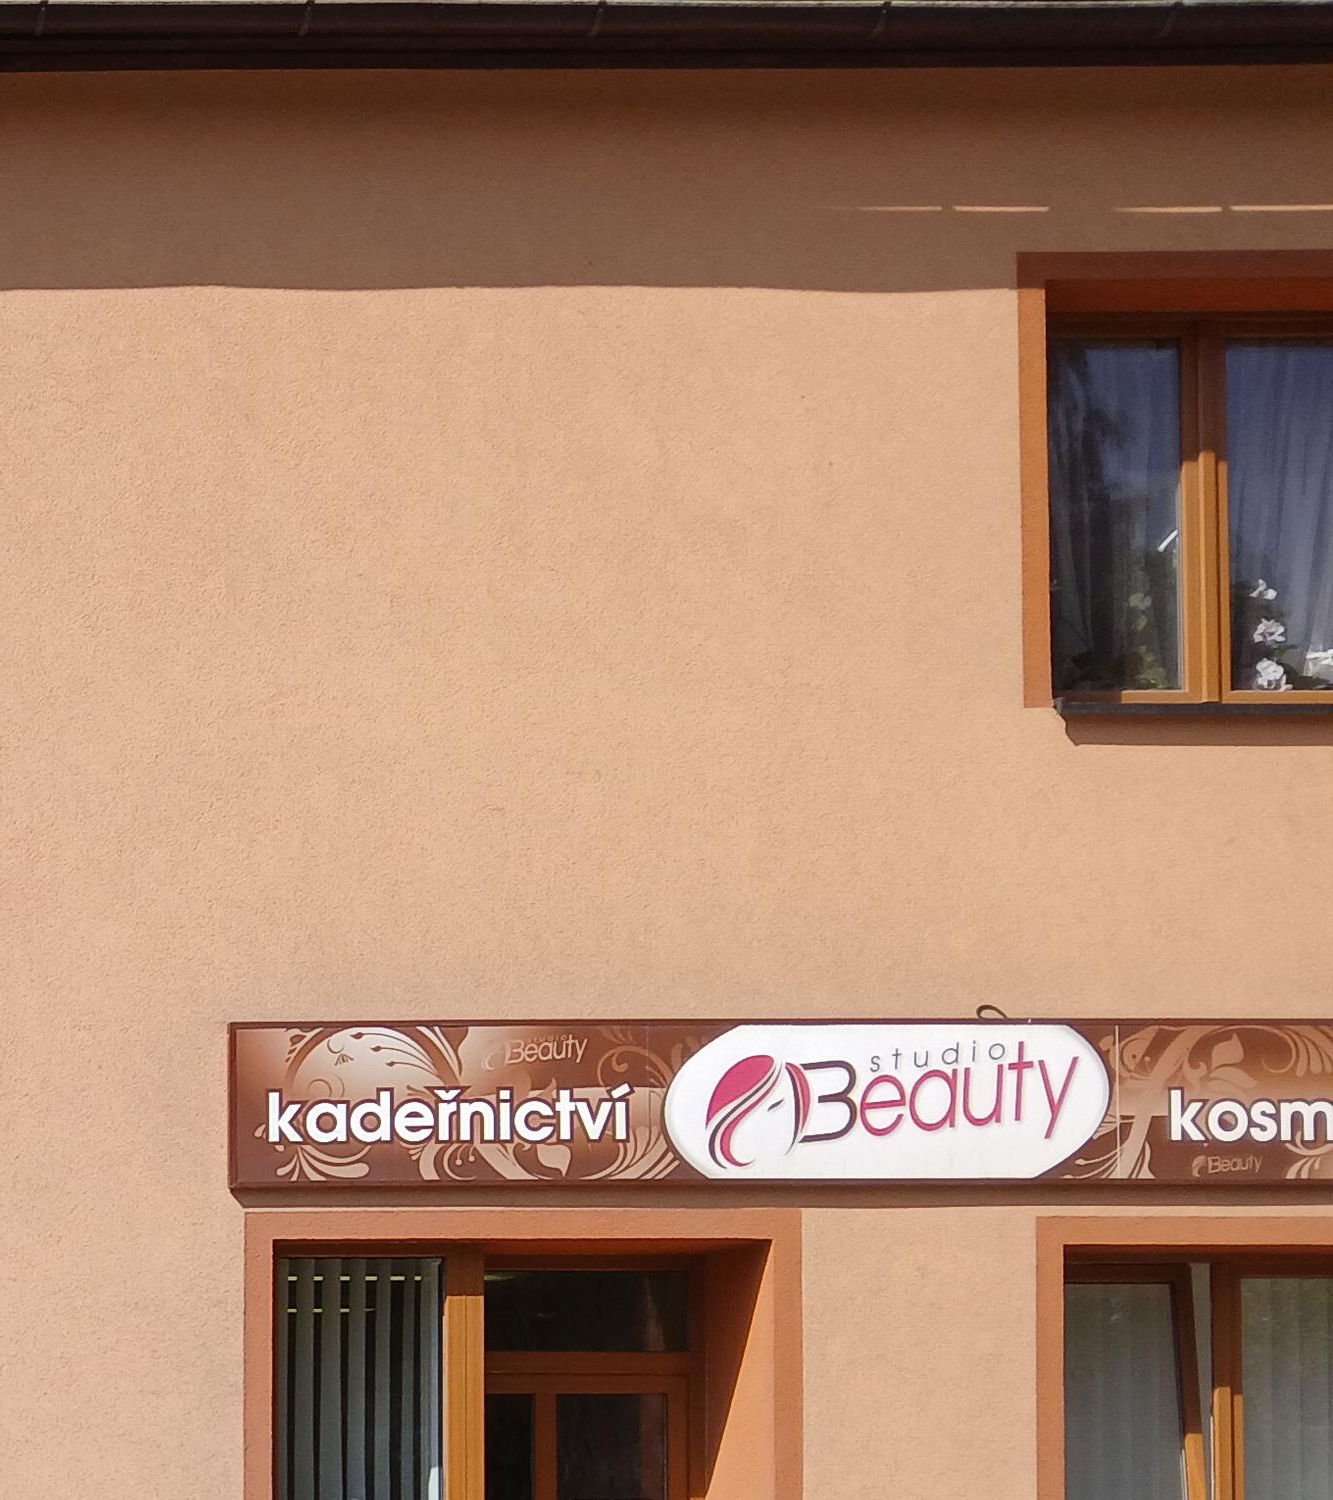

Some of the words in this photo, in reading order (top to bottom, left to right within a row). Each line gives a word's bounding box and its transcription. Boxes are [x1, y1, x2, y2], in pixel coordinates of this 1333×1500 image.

[506, 1033, 588, 1064] Beauty
[868, 1041, 1007, 1073] studio
[797, 1040, 1081, 1143] Beauty
[267, 1083, 637, 1145] kadeřnictví
[1207, 1154, 1264, 1174] Beauty
